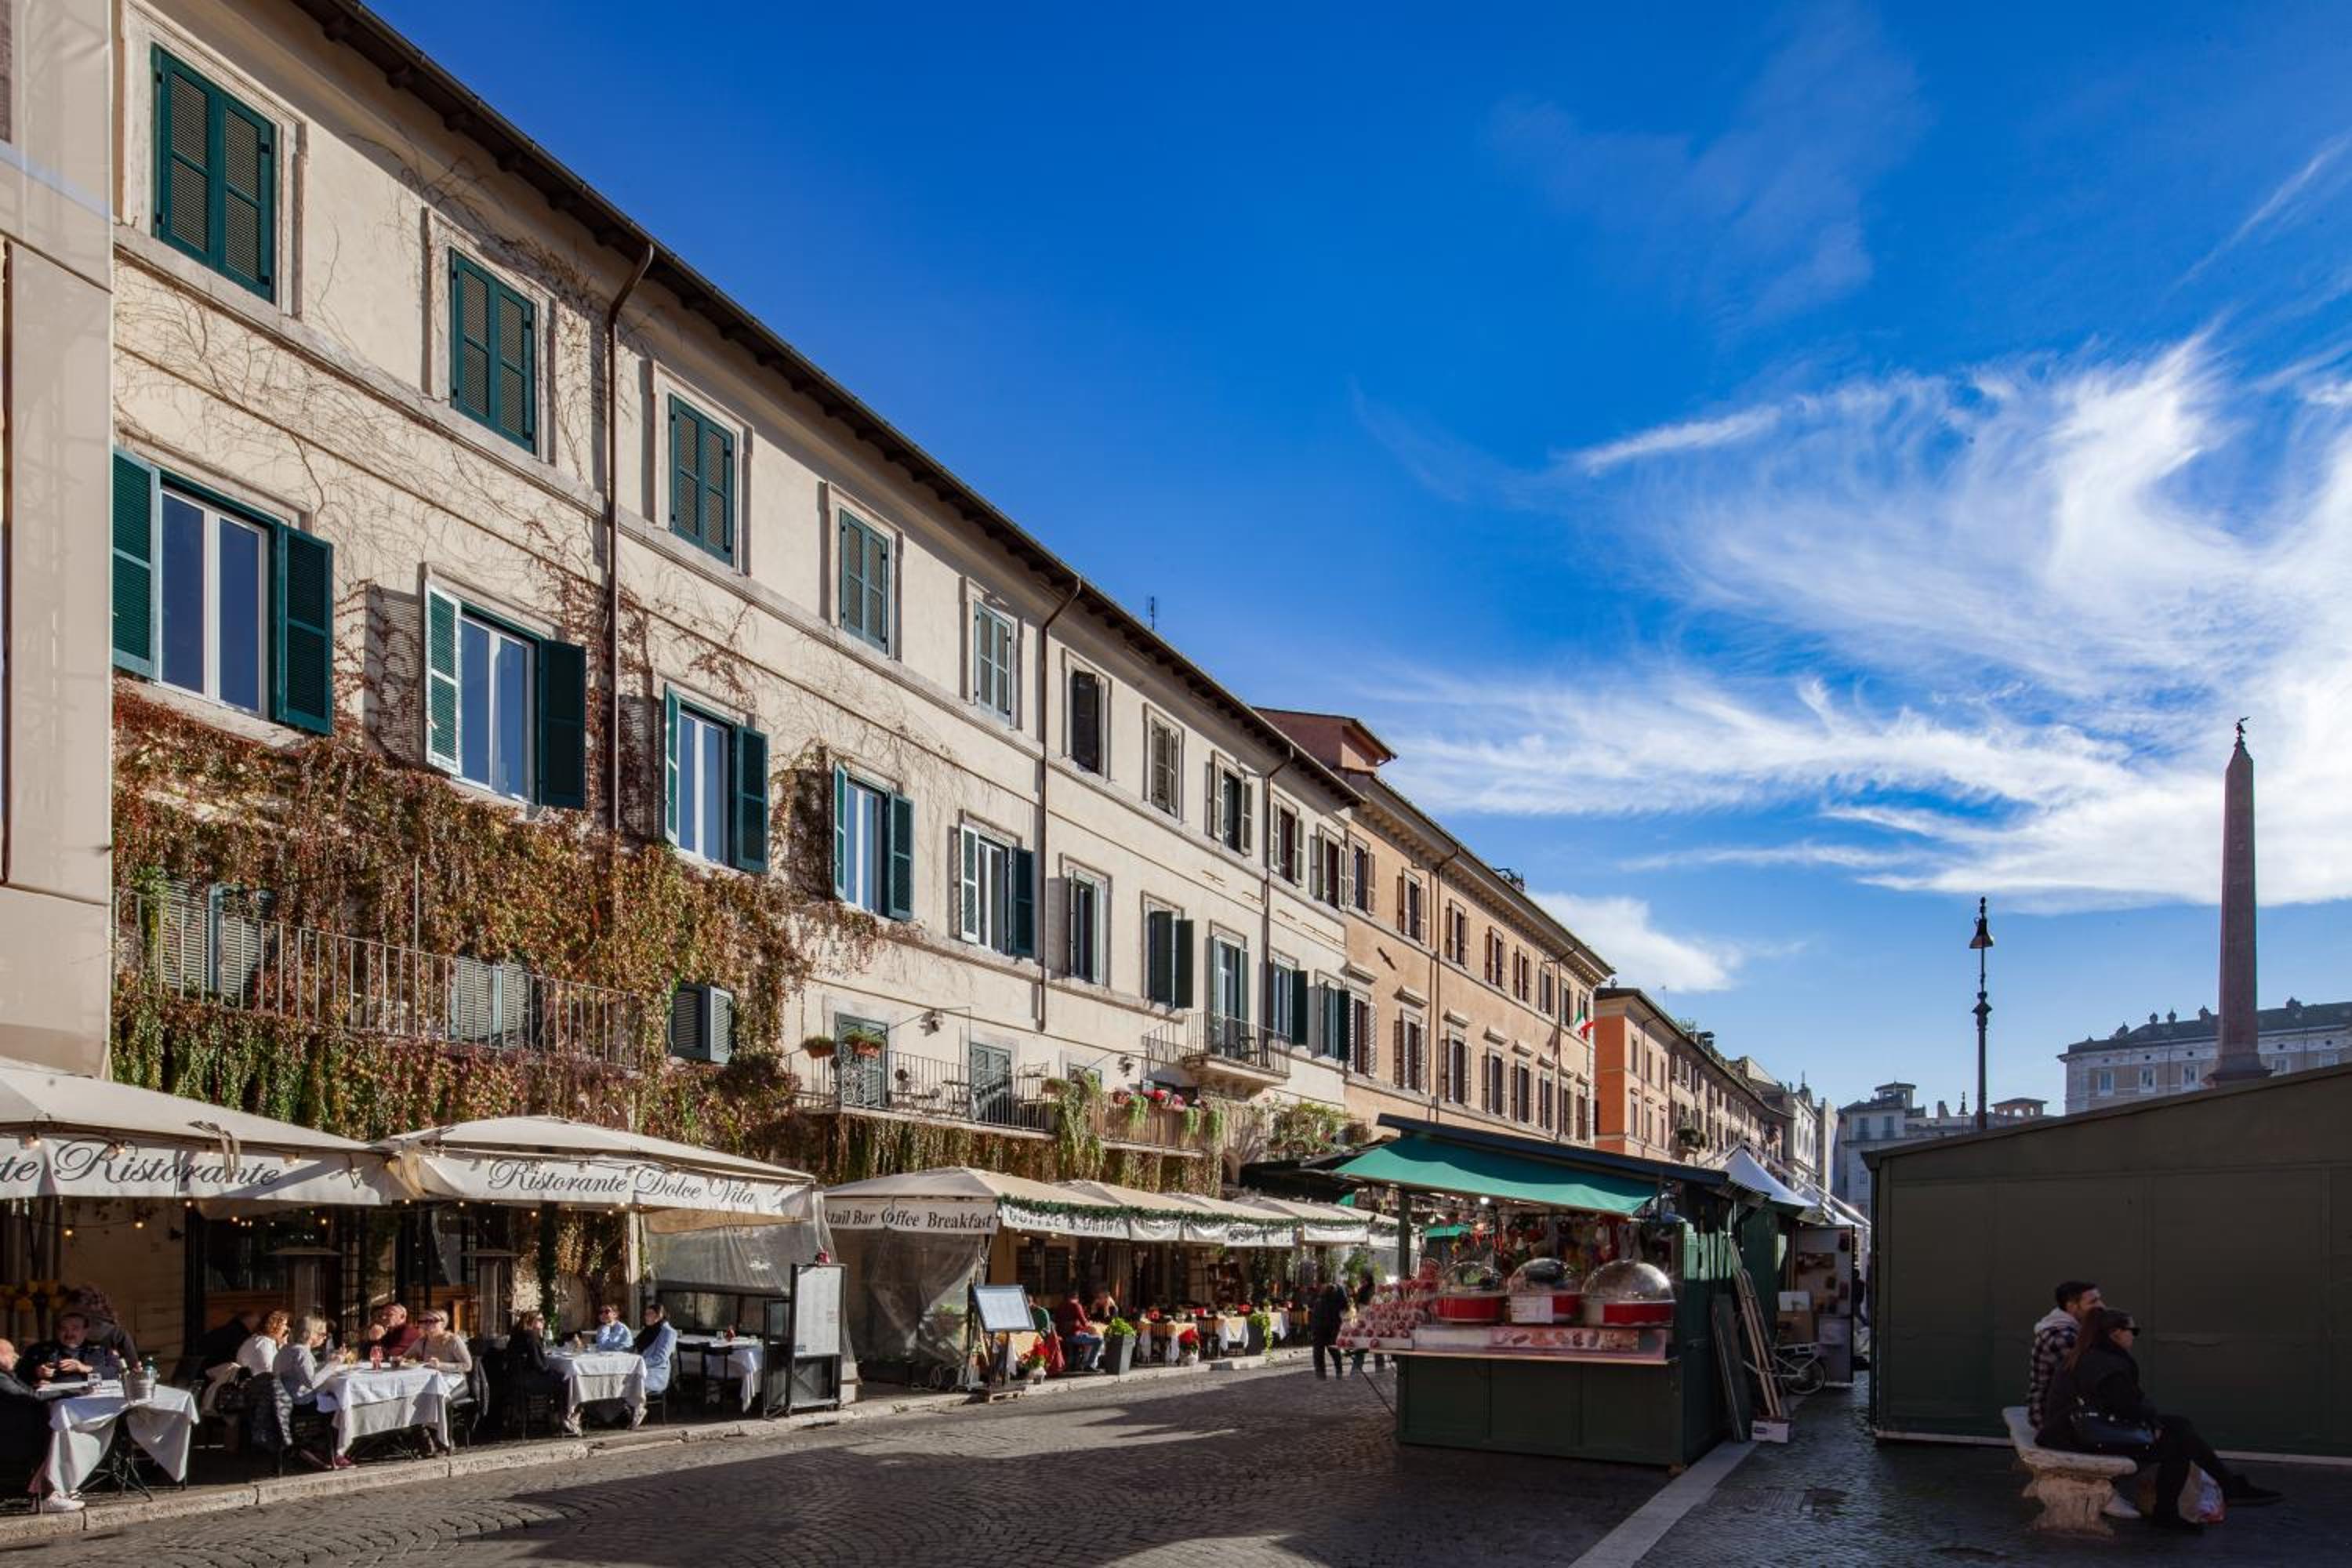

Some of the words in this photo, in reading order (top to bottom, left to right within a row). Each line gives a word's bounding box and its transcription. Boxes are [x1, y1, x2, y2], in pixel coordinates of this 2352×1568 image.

[53, 1138, 281, 1185] Ristorante
[488, 1160, 627, 1192] Ristorante
[635, 1163, 702, 1199] Dolce
[708, 1178, 755, 1204] Vita
[852, 1210, 876, 1225] Bar
[880, 1207, 920, 1227] Coffee
[927, 1210, 993, 1229] Breakfast
